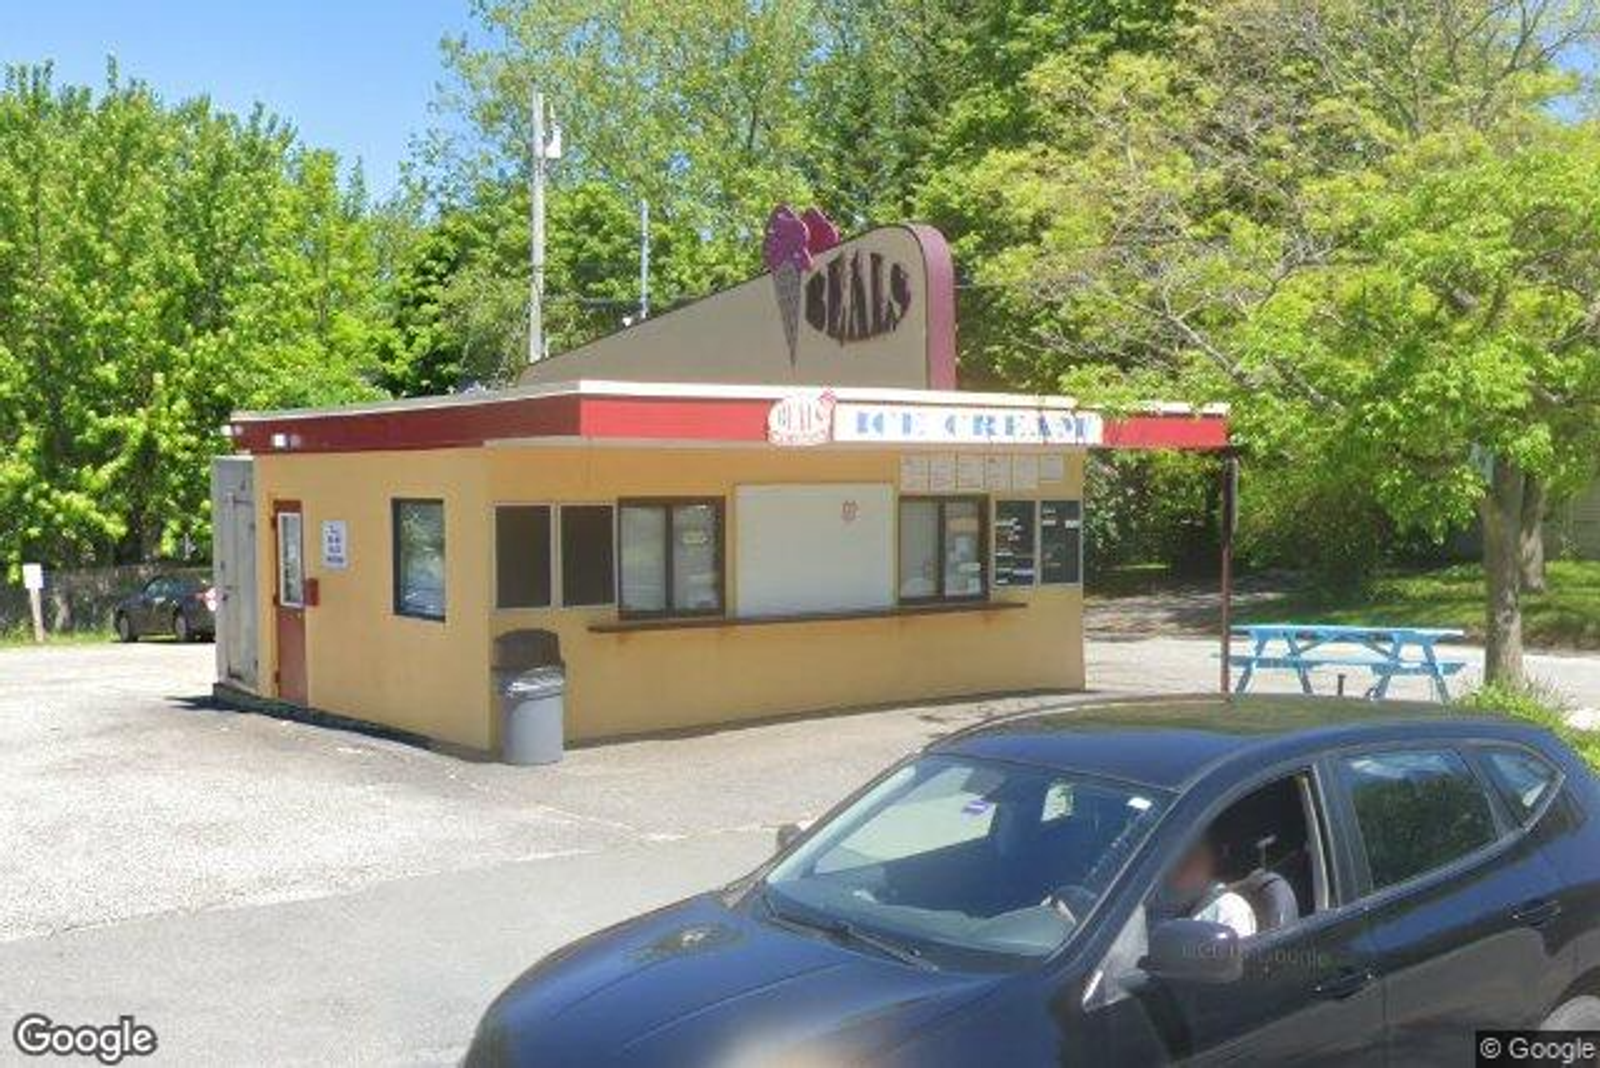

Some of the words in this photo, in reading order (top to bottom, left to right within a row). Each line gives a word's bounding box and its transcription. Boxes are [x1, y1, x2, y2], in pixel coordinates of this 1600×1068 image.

[805, 249, 912, 347] BEALS
[855, 411, 927, 436] ICE
[941, 413, 1091, 439] CREAM
